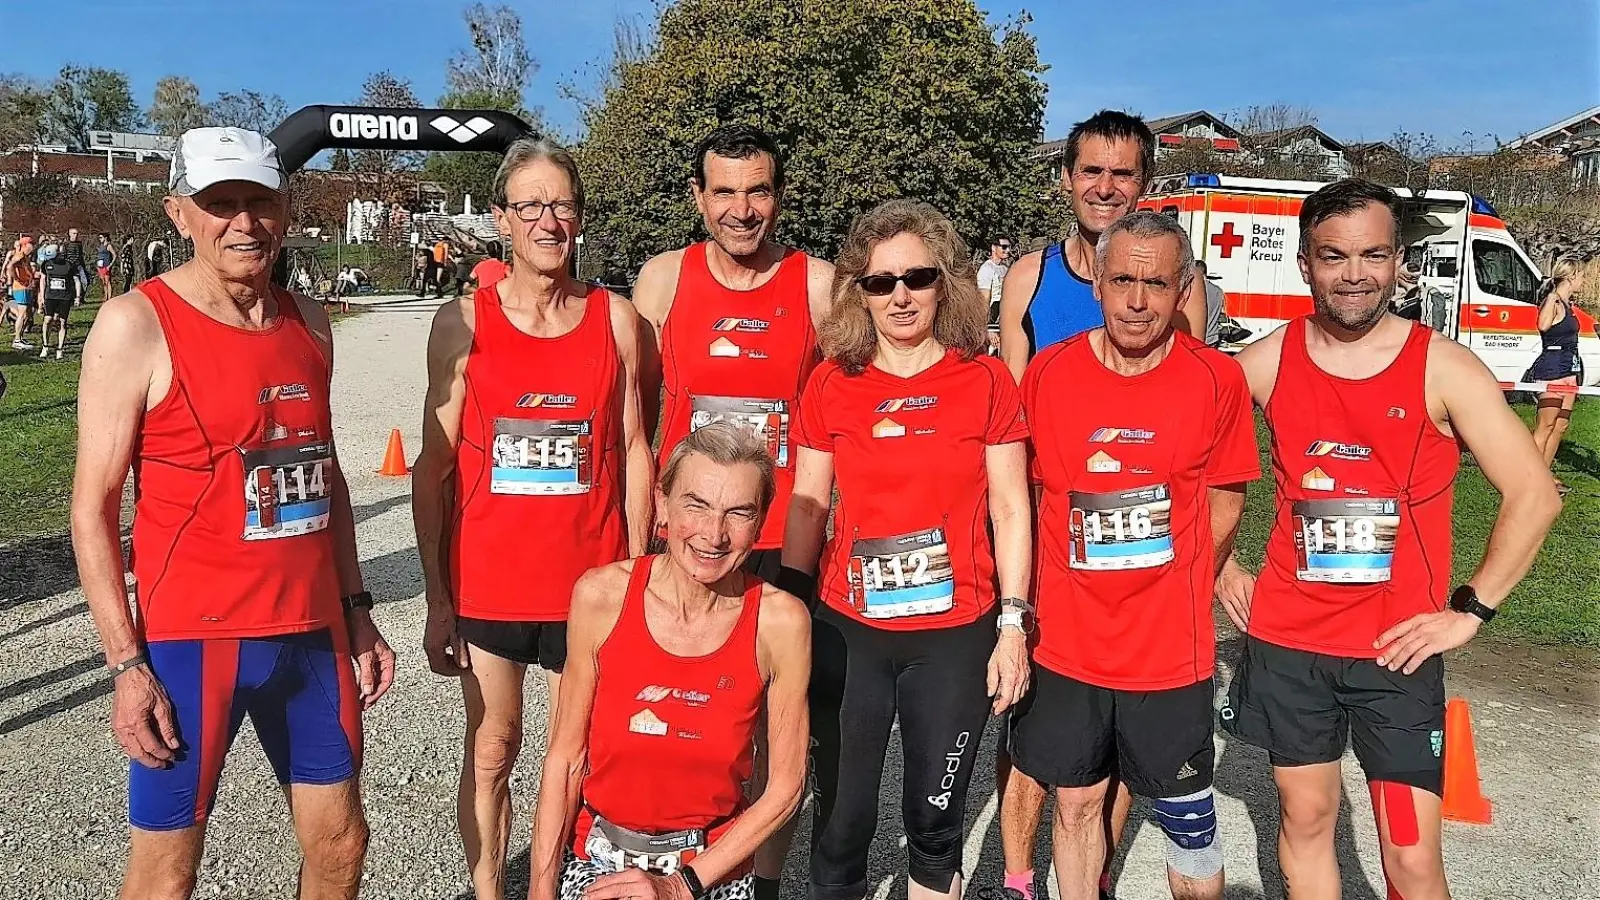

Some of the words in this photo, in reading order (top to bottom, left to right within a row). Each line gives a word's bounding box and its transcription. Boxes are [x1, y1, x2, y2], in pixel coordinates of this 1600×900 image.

[329, 112, 418, 141] arena
[1250, 249, 1283, 262] Kreuz
[515, 437, 573, 468] 115
[261, 486, 271, 509] 114
[271, 462, 326, 503] 114
[1085, 507, 1152, 541] 116
[1310, 518, 1376, 554] 118
[870, 551, 933, 589] 112
[941, 731, 970, 790] odlo
